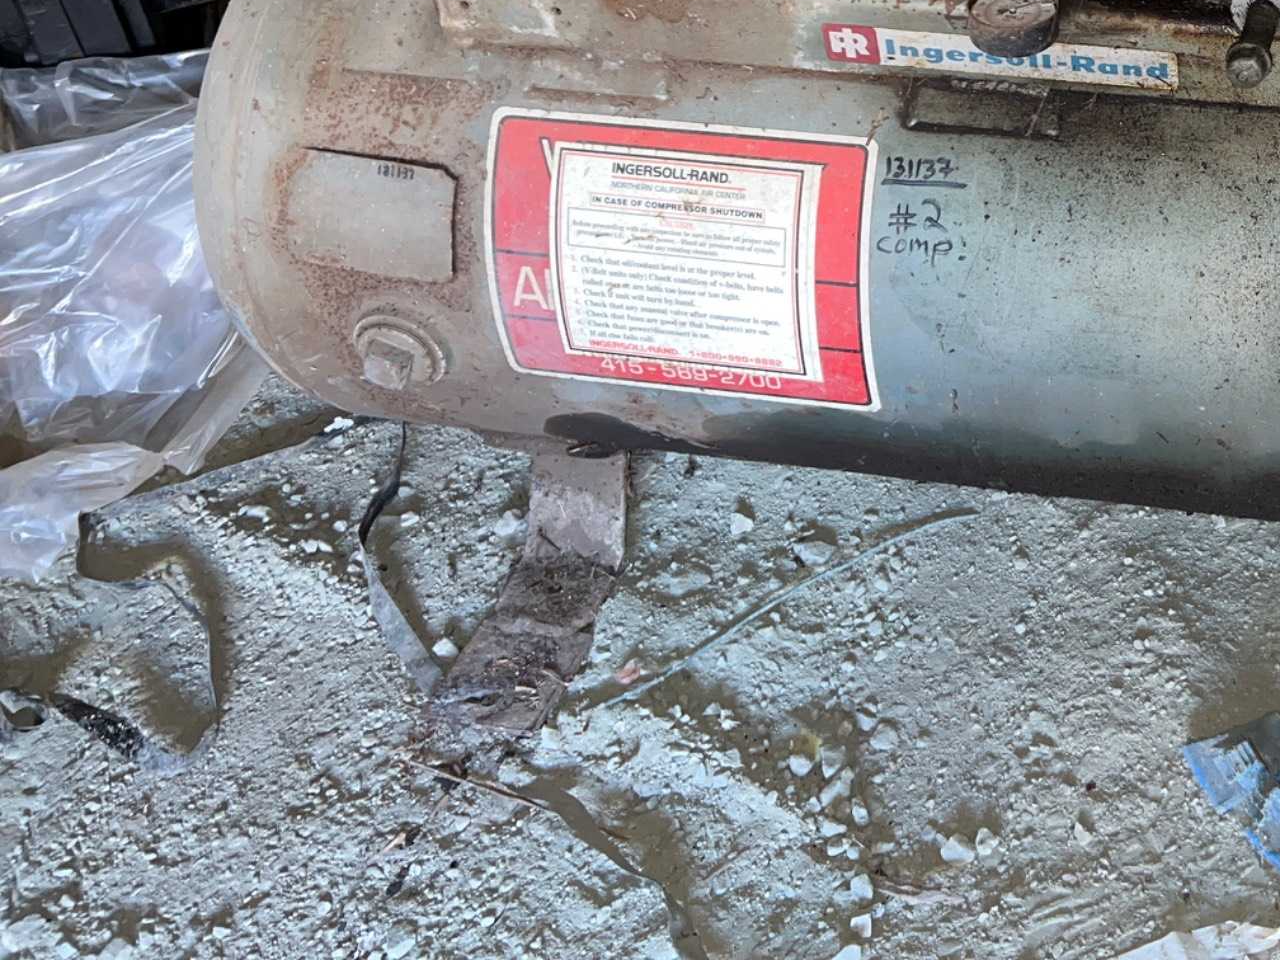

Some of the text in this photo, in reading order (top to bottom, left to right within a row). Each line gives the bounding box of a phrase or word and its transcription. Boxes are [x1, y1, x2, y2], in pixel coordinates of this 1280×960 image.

[592, 195, 763, 220] IN CASE OF COMPRESSOR SHUTDOWN
[888, 198, 949, 235] #2
